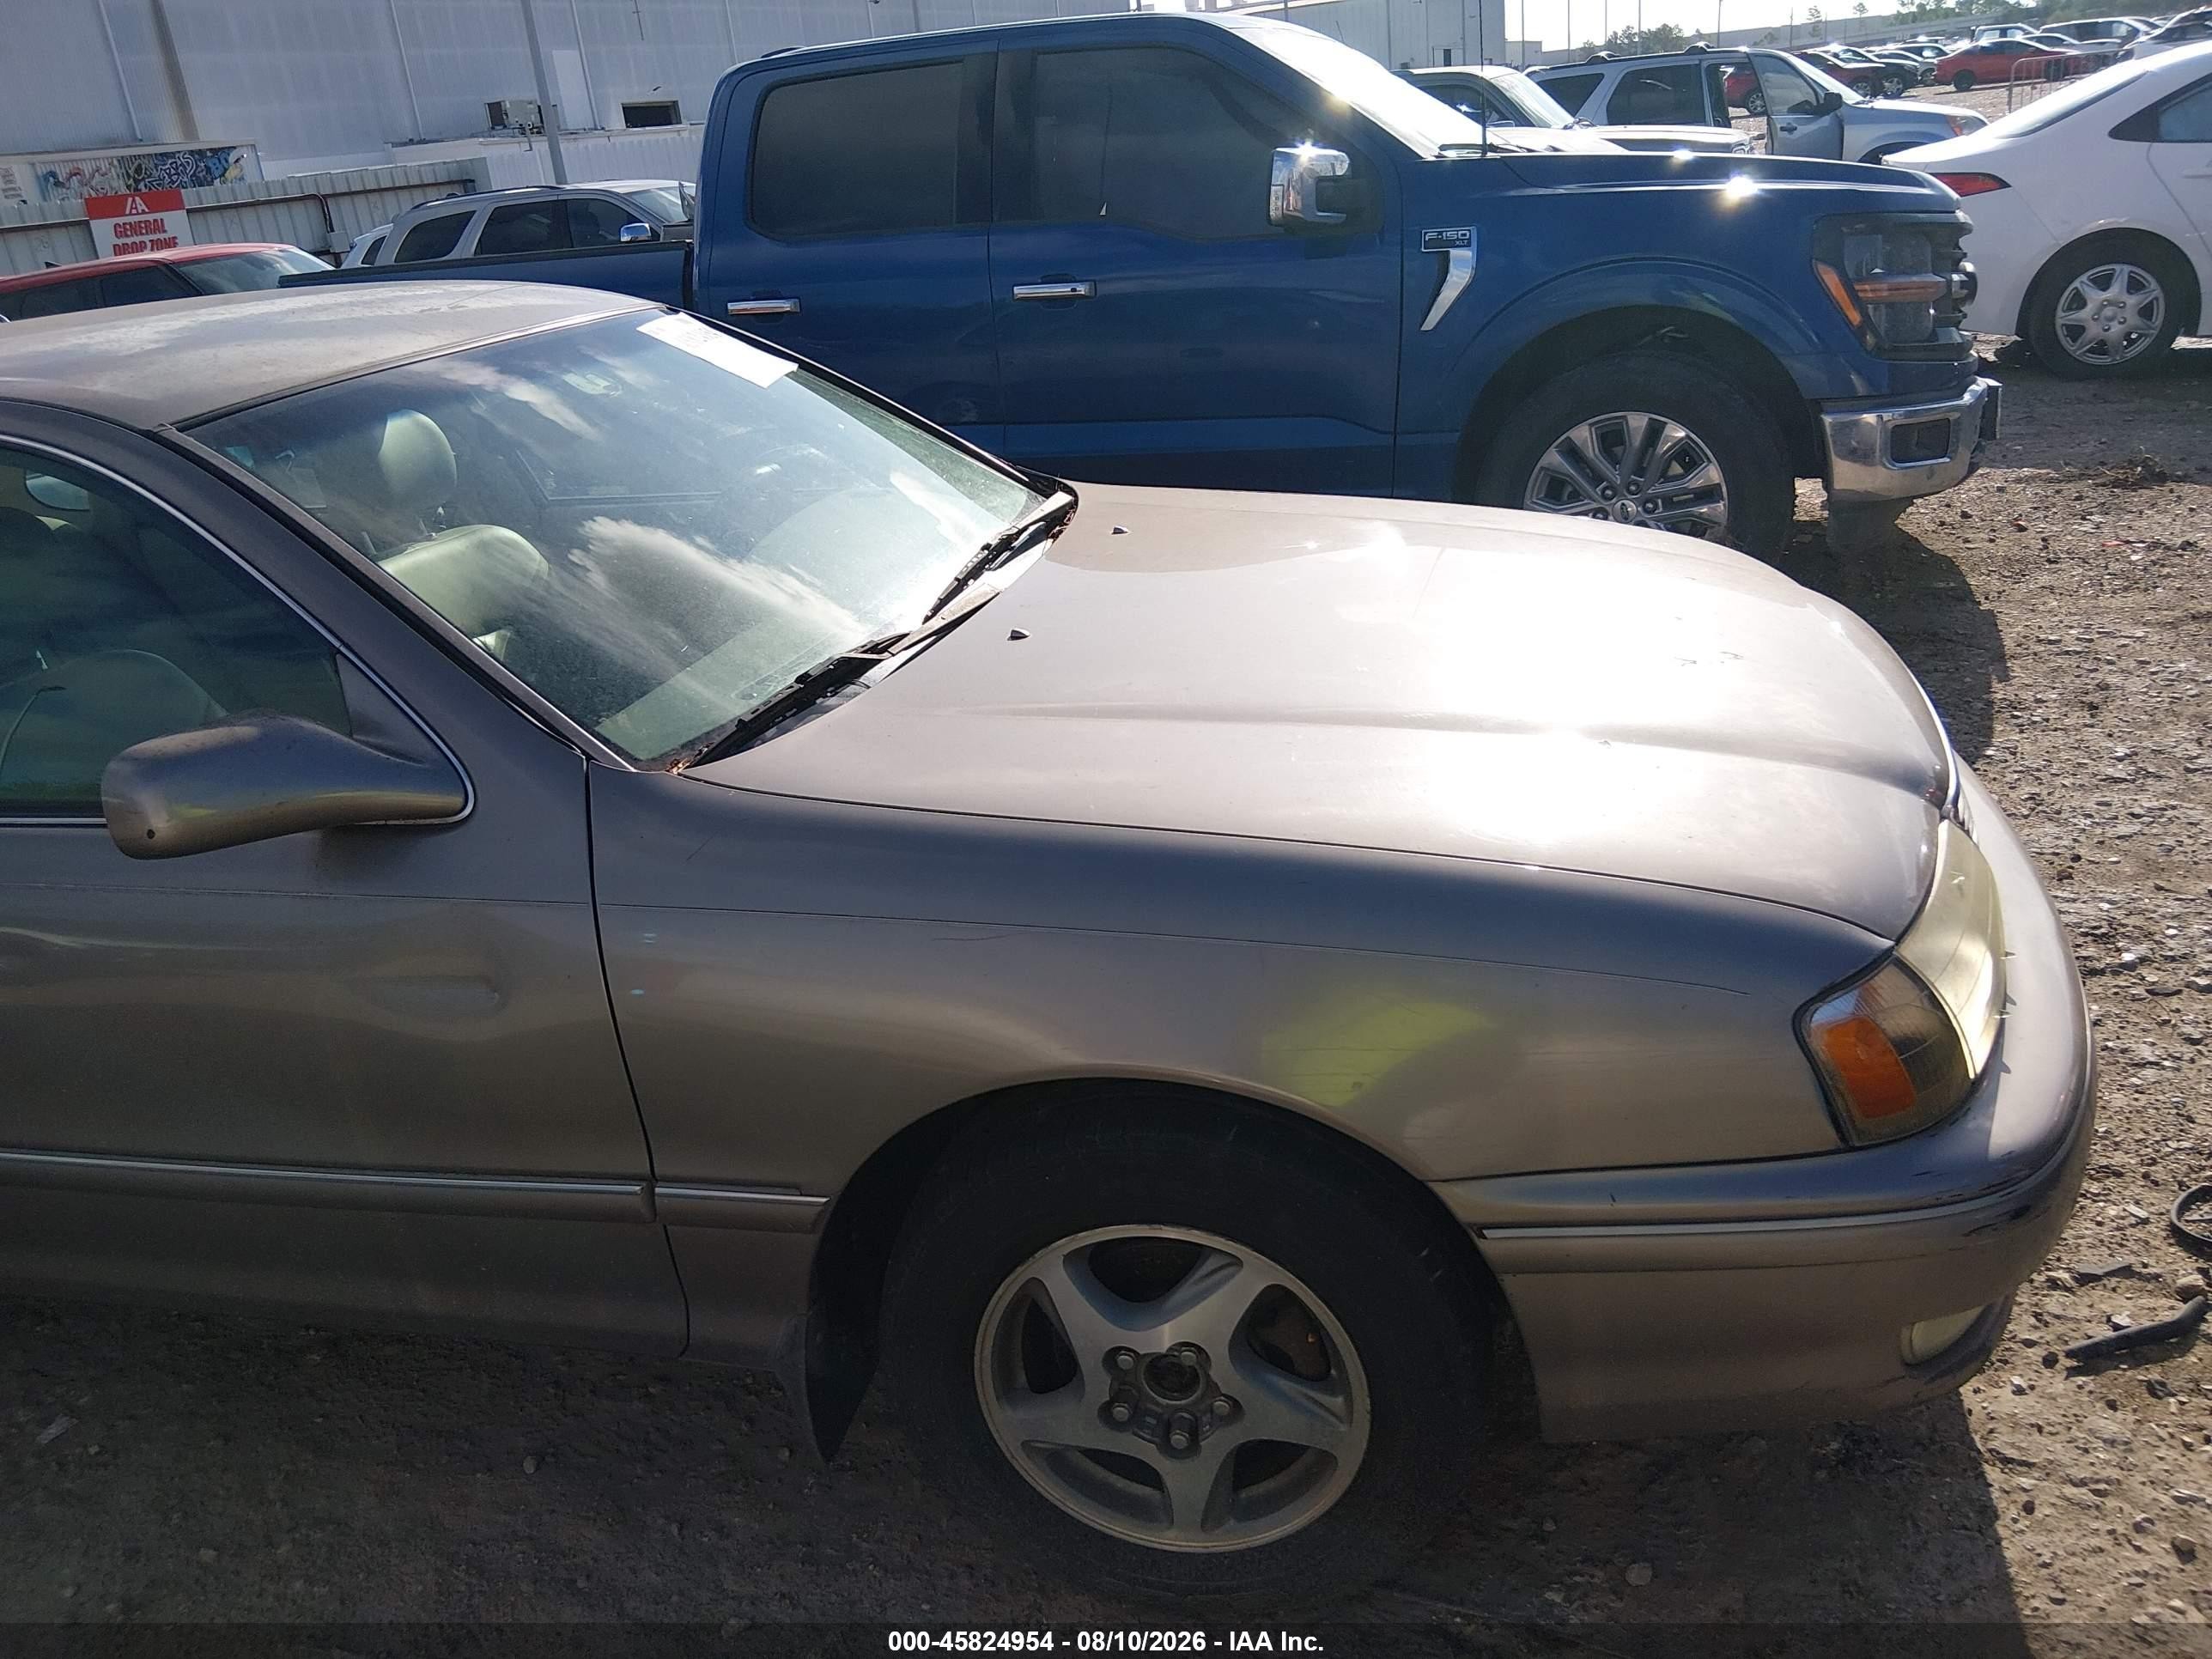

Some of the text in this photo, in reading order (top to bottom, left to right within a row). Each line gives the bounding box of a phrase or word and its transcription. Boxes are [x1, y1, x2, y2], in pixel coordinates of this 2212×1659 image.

[113, 218, 167, 239] GENERAL
[1425, 231, 1469, 240] F-150
[112, 235, 179, 257] DROP ZONE
